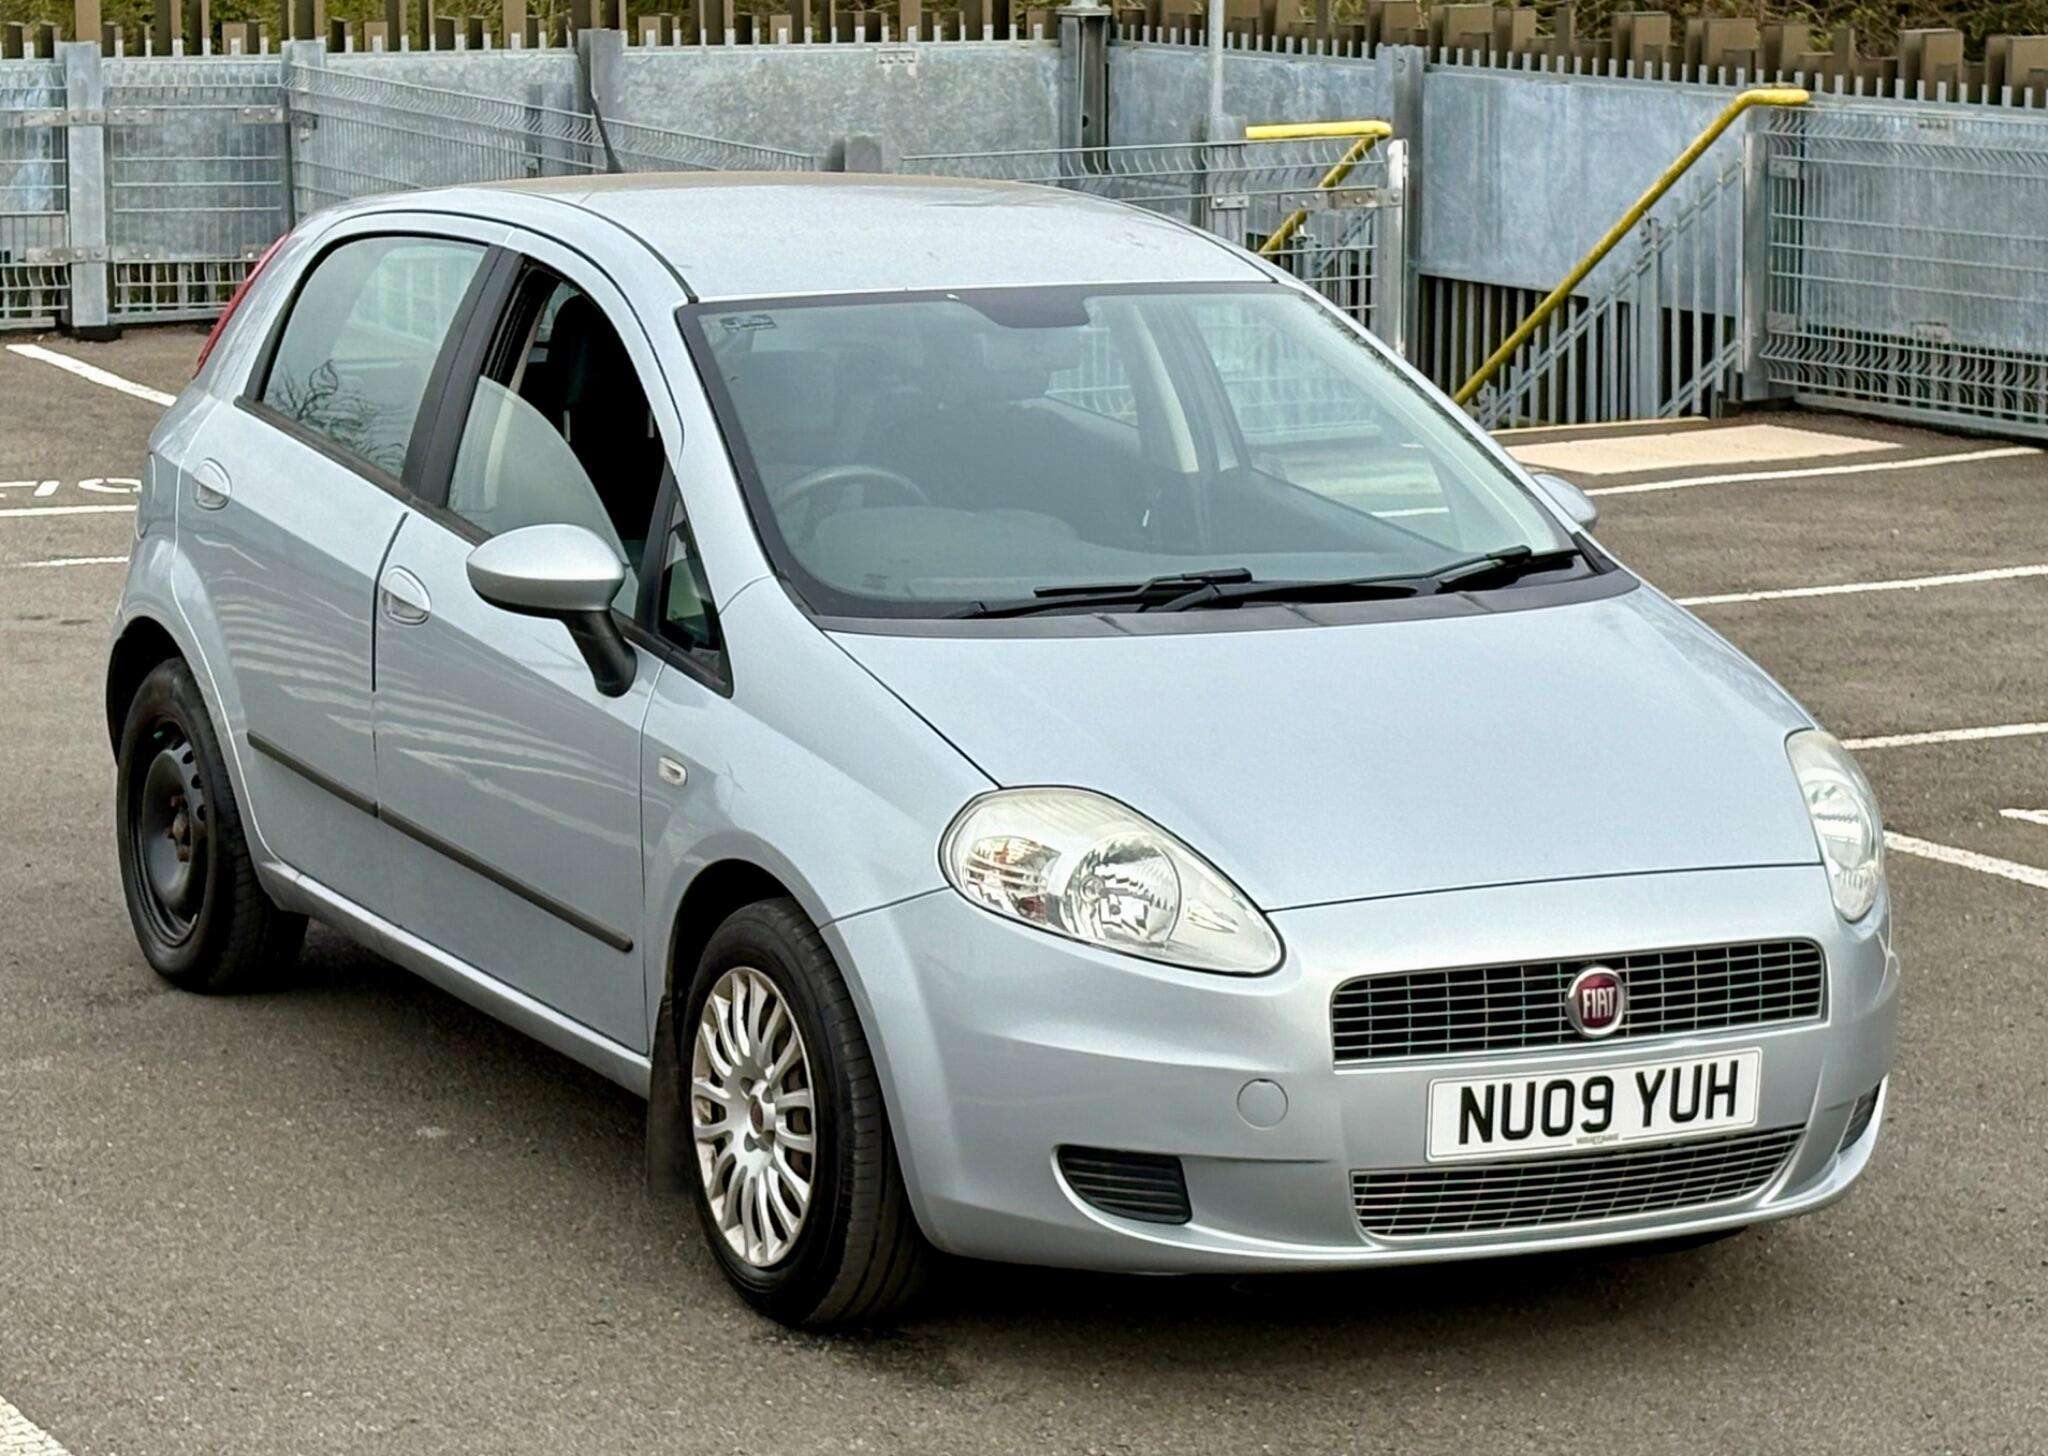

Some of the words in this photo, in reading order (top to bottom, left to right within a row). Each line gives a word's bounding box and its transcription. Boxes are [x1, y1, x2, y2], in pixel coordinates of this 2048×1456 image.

[1582, 986, 1615, 1019] FIAT
[1458, 1075, 1615, 1146] NU09
[1635, 1060, 1739, 1128] YUH
